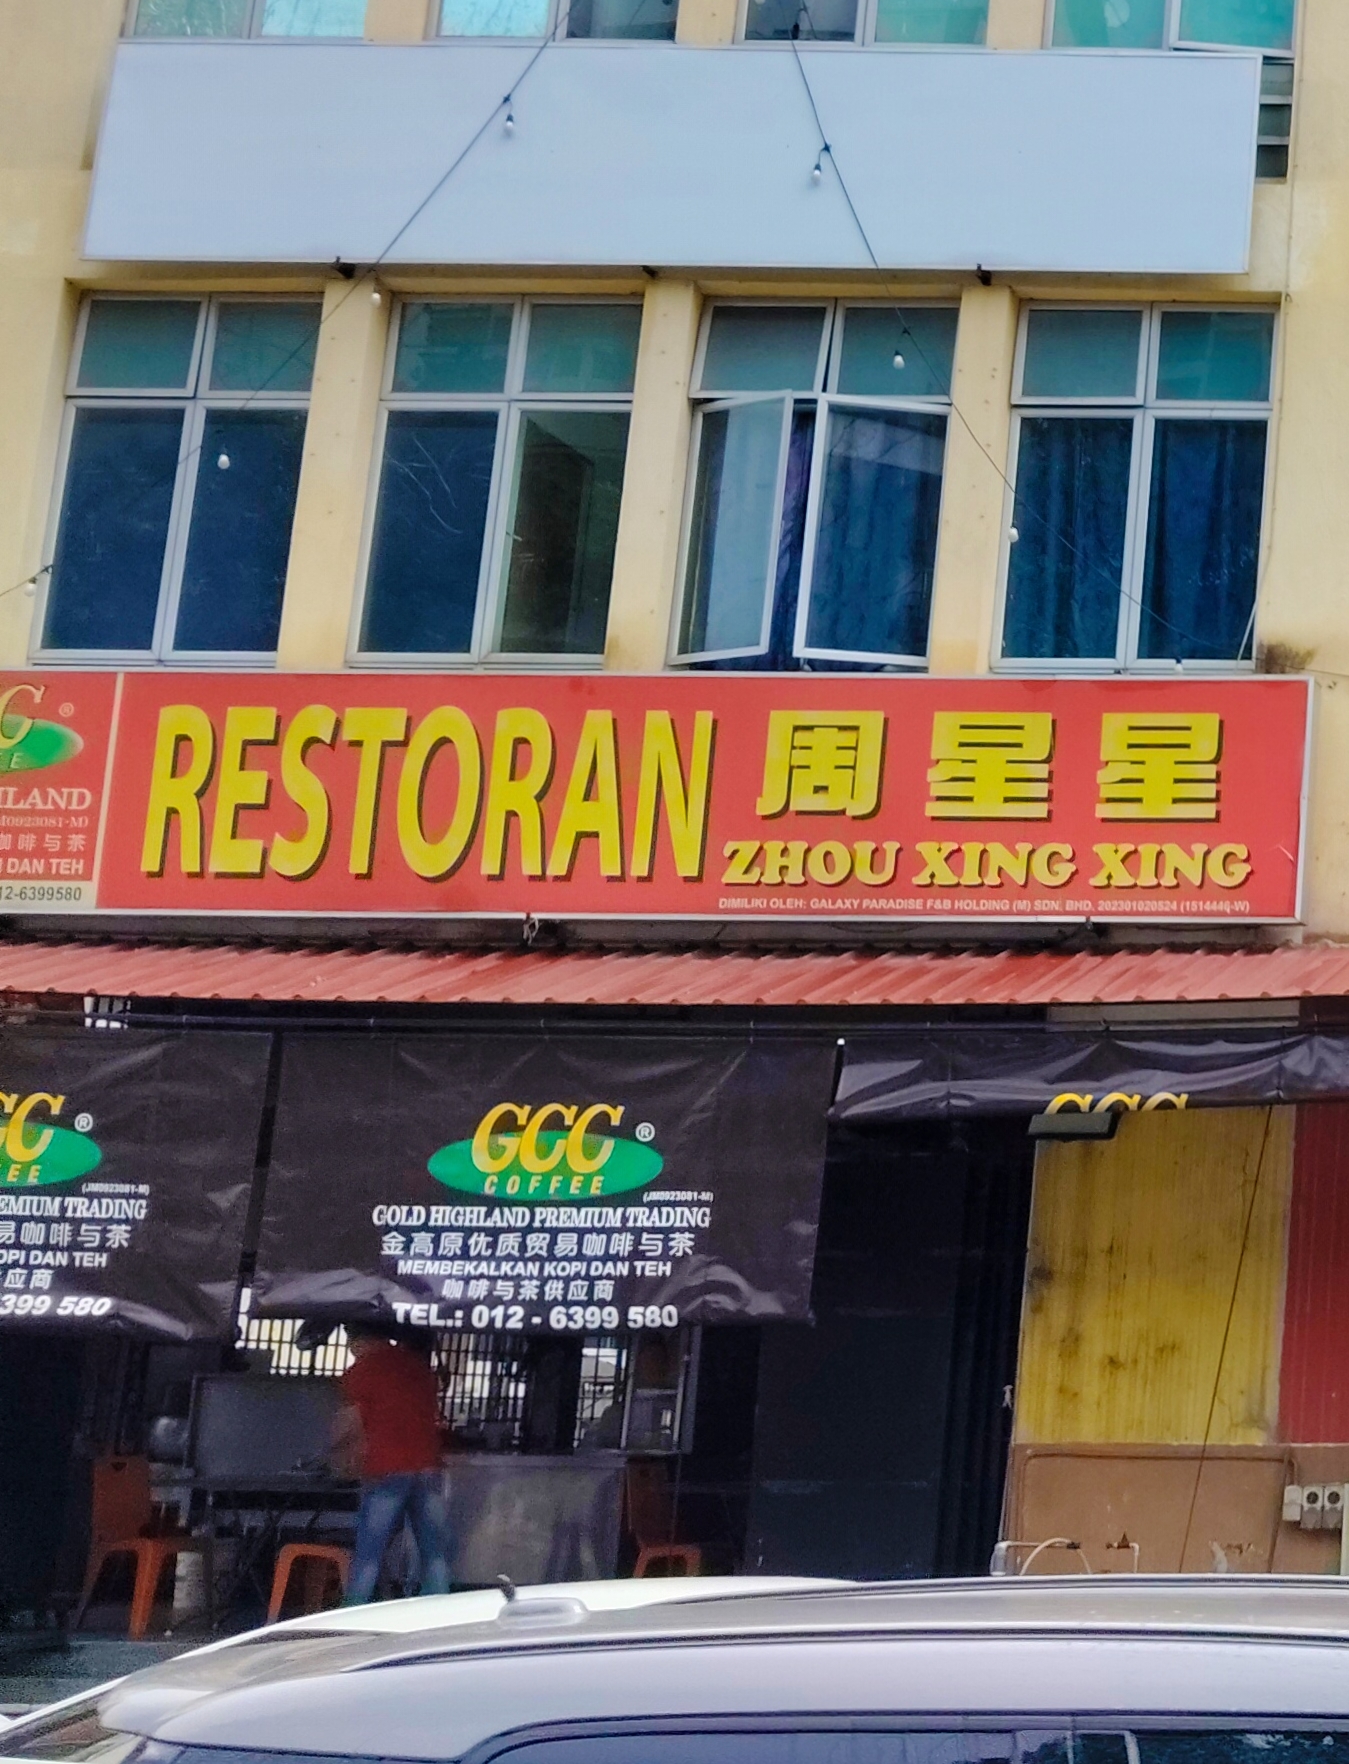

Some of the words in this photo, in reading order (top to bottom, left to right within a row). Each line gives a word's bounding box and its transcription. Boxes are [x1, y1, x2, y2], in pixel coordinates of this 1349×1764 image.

[757, 710, 1221, 820] 周星星
[141, 703, 715, 880] RESTORAN
[7, 859, 45, 875] DAN
[49, 860, 84, 876] TEH
[721, 840, 901, 887] ZHOU
[912, 841, 1076, 888] XING
[1089, 842, 1252, 889] XING
[718, 897, 767, 909] DIMILIKI
[809, 898, 859, 910] GALAXY
[861, 898, 924, 911] PARADISE
[926, 899, 951, 911] F&B
[954, 899, 1009, 911] HOLDING
[1011, 899, 1031, 912] (M)
[471, 1102, 625, 1173] GCC
[483, 1175, 605, 1195] COFFEE
[64, 1197, 148, 1219] TRADING
[372, 1205, 426, 1227] GOLD
[428, 1205, 531, 1228] HIGHLAND
[532, 1206, 623, 1228] PREMIUM
[624, 1206, 711, 1229] TRADING
[380, 1231, 696, 1258] 金高原优质贸易咖啡与茶
[28, 1250, 69, 1267] DAN
[72, 1251, 108, 1268] TEH
[397, 1260, 542, 1277] MEMBEKALKAN
[544, 1260, 587, 1277] KOPI
[589, 1261, 630, 1277] DAN
[633, 1261, 672, 1277] TEH
[441, 1279, 616, 1300] 咖啡与茶供应商
[56, 1297, 112, 1316] 580
[471, 1305, 524, 1329] 012
[549, 1306, 620, 1329] 6399
[627, 1305, 679, 1328] 580
